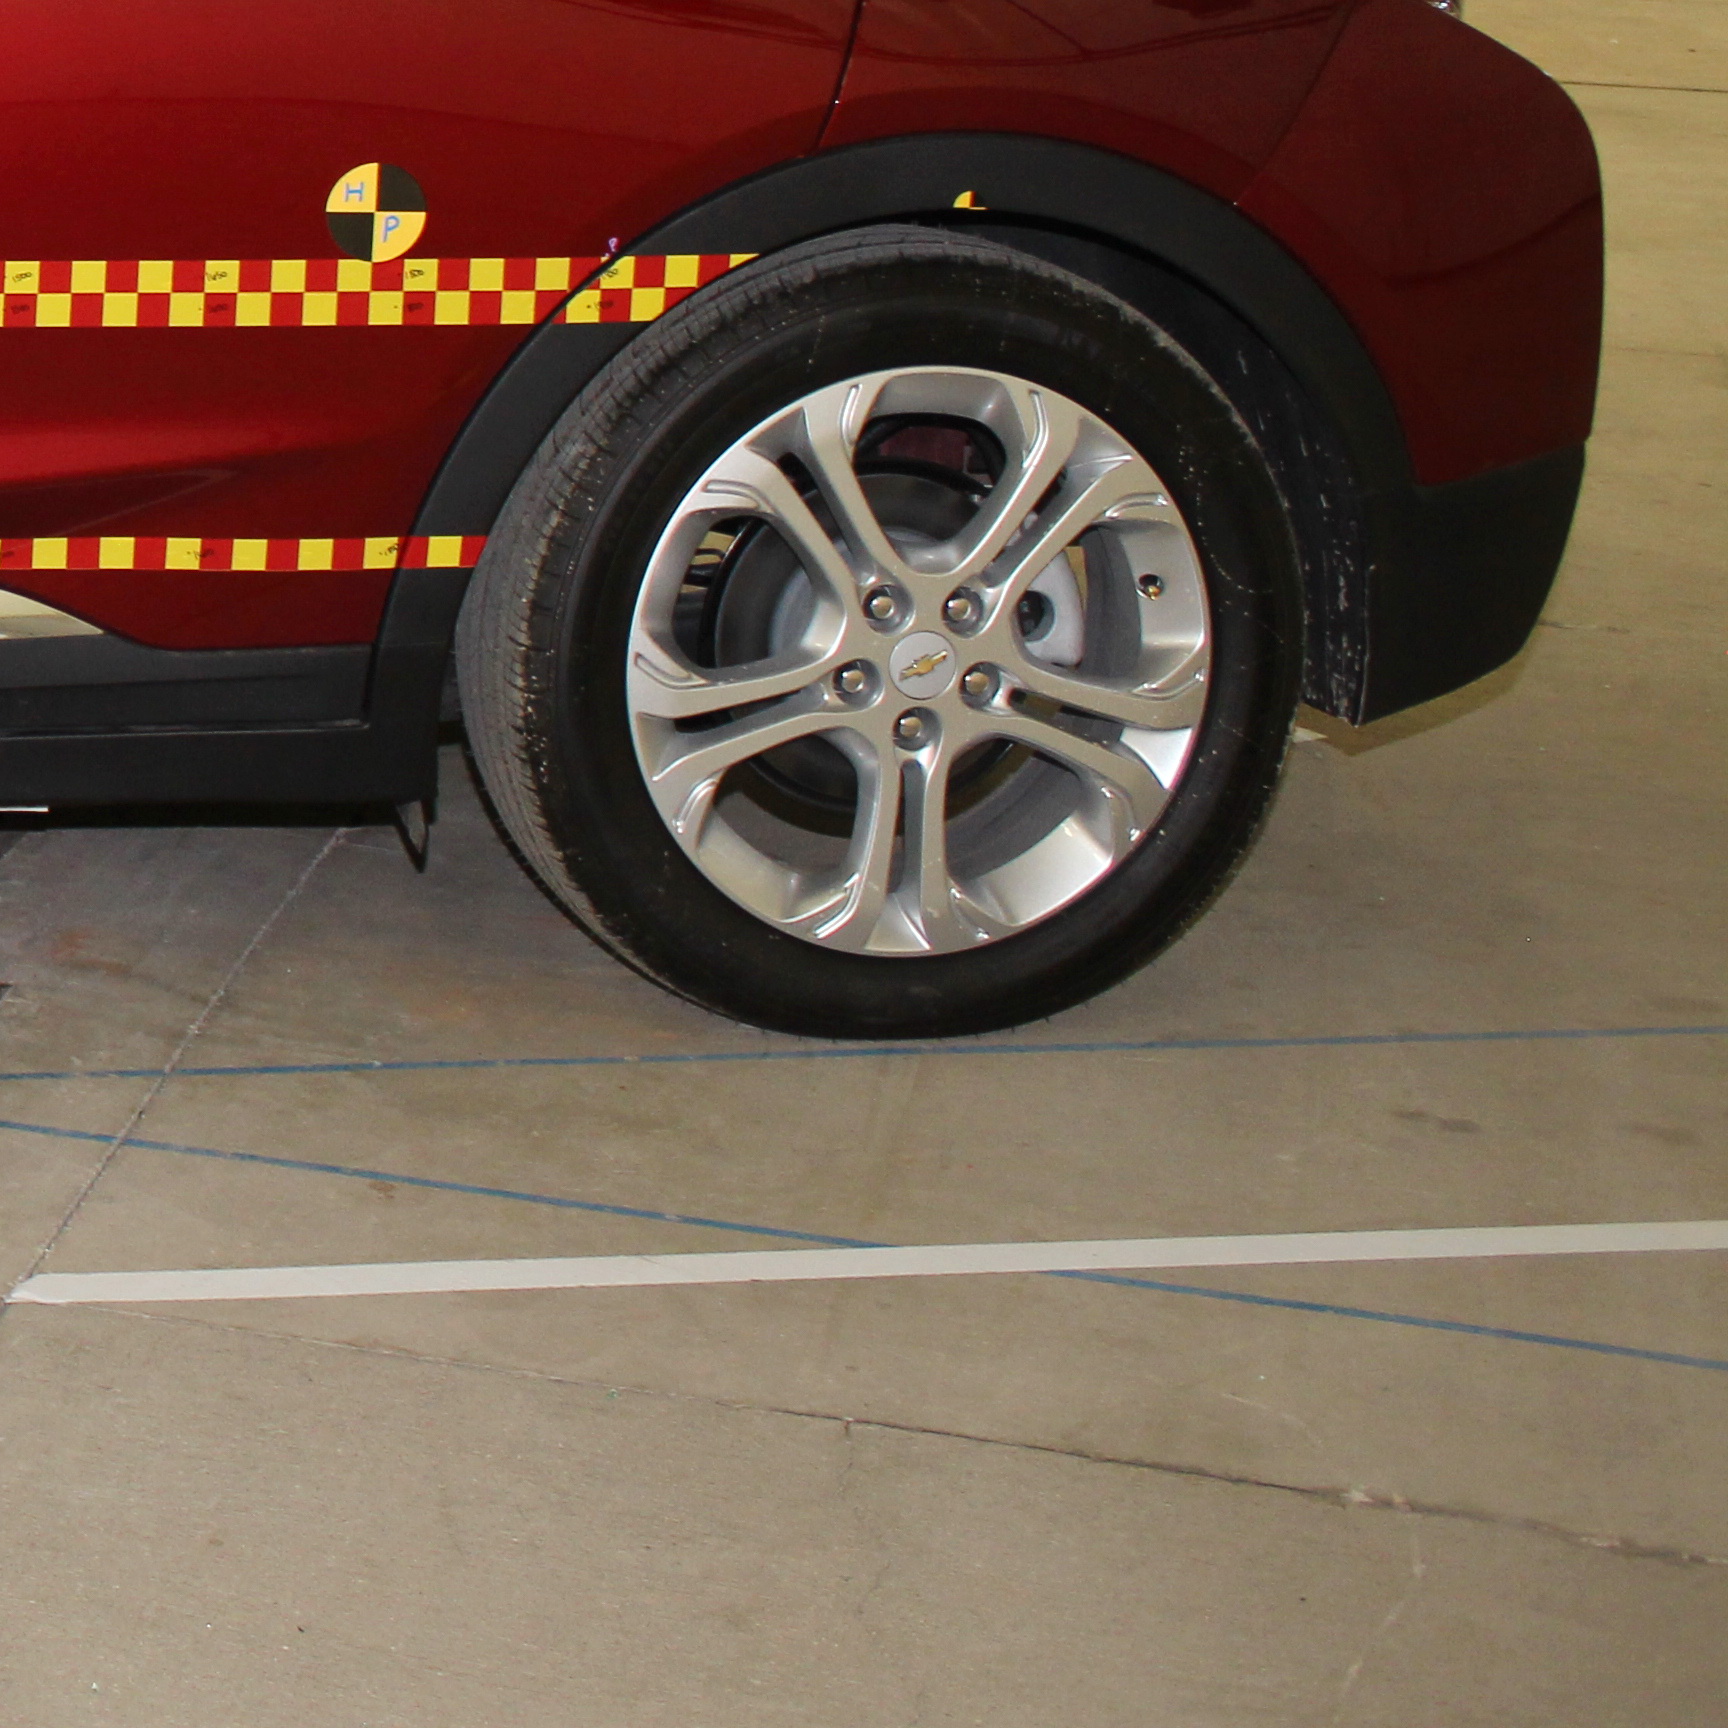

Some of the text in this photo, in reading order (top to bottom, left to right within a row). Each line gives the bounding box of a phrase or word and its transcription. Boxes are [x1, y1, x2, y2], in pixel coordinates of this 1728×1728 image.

[344, 181, 365, 203] H
[382, 215, 400, 243] P
[12, 271, 33, 283] 1500
